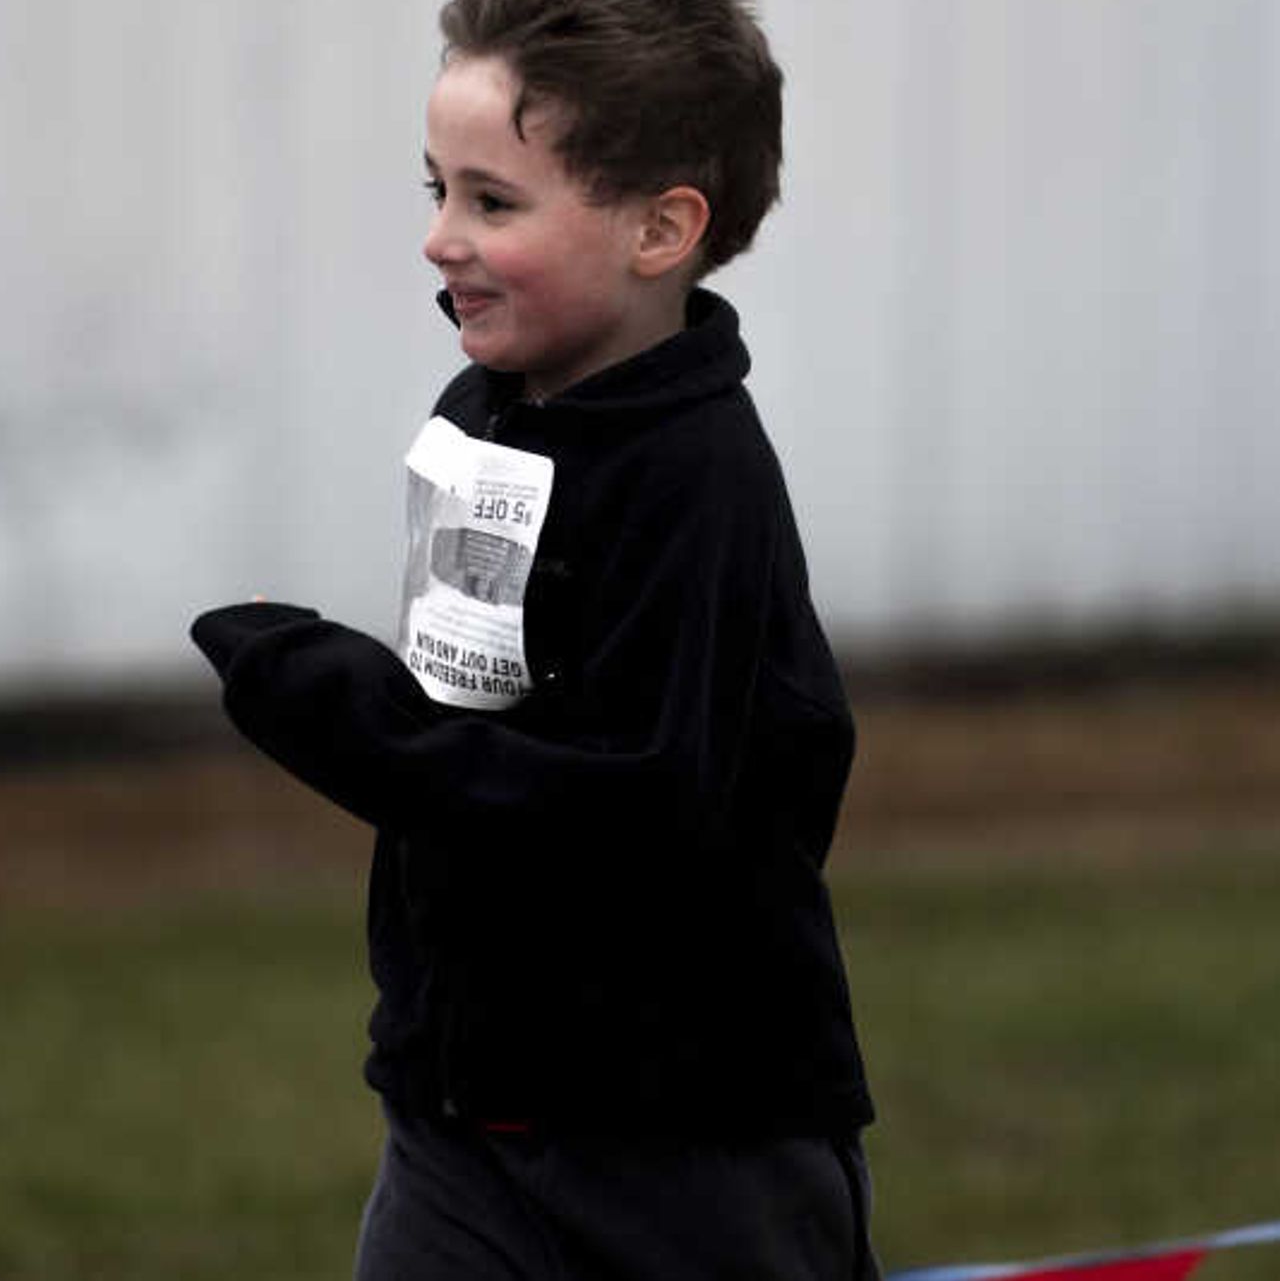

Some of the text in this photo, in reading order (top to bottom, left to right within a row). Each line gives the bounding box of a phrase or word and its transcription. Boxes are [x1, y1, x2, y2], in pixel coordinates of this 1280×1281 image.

[473, 497, 508, 520] OFF
[461, 650, 487, 672] OUT
[492, 657, 521, 677] GET
